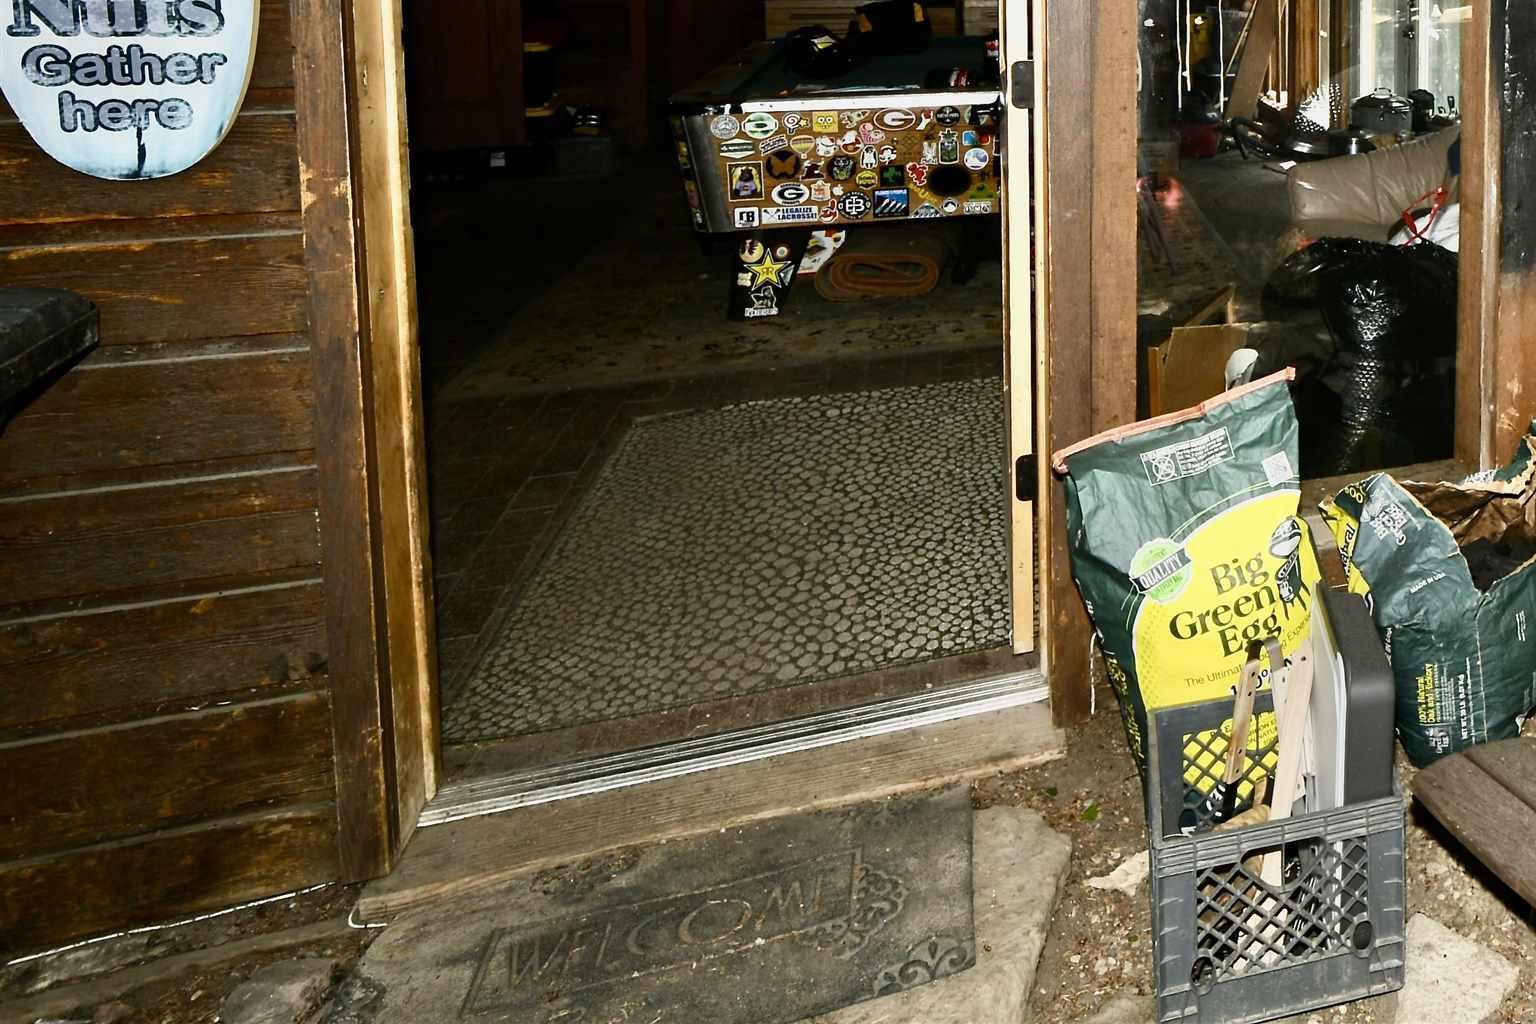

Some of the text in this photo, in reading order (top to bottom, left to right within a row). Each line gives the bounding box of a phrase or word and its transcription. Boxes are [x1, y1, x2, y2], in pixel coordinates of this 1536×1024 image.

[21, 43, 227, 86] Gather
[58, 90, 195, 133] here
[1139, 553, 1183, 589] QUALITY
[1210, 552, 1269, 595] Big
[1169, 585, 1276, 640] Green
[1185, 676, 1205, 689] The
[1207, 663, 1243, 682] Ultimat
